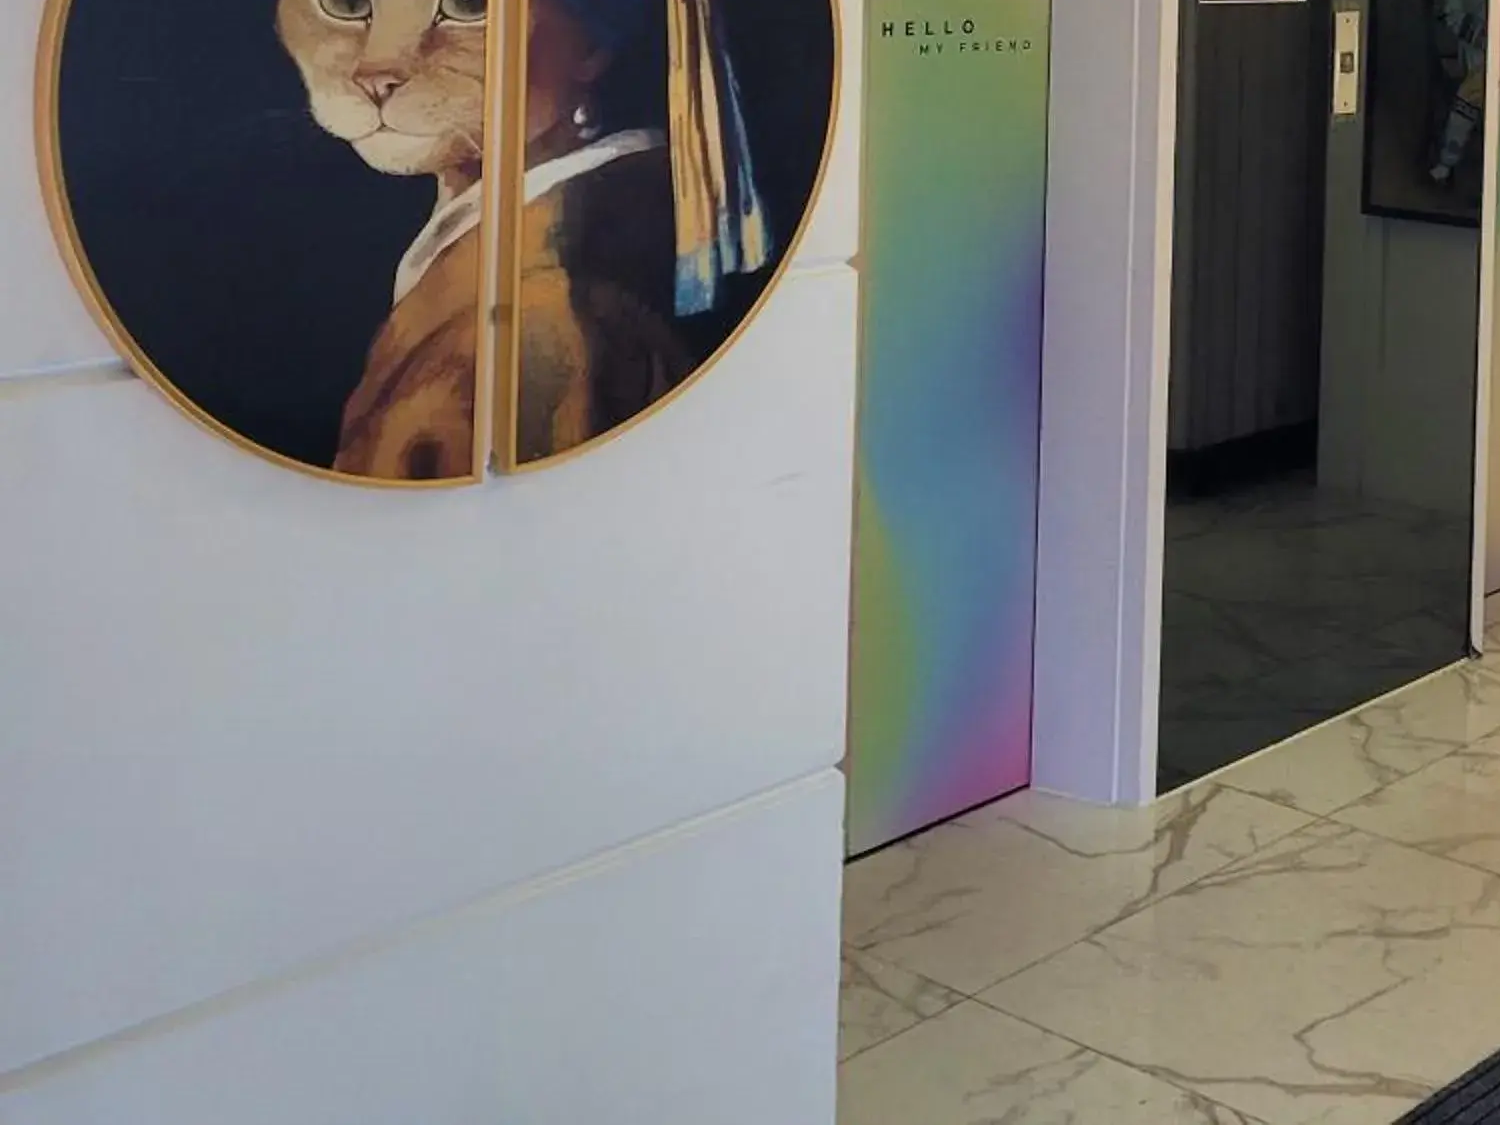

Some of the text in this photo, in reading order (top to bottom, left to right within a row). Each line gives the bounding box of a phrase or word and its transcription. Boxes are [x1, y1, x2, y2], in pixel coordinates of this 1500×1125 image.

[881, 19, 975, 37] HELLO
[919, 39, 1032, 55] MY FRIEND
